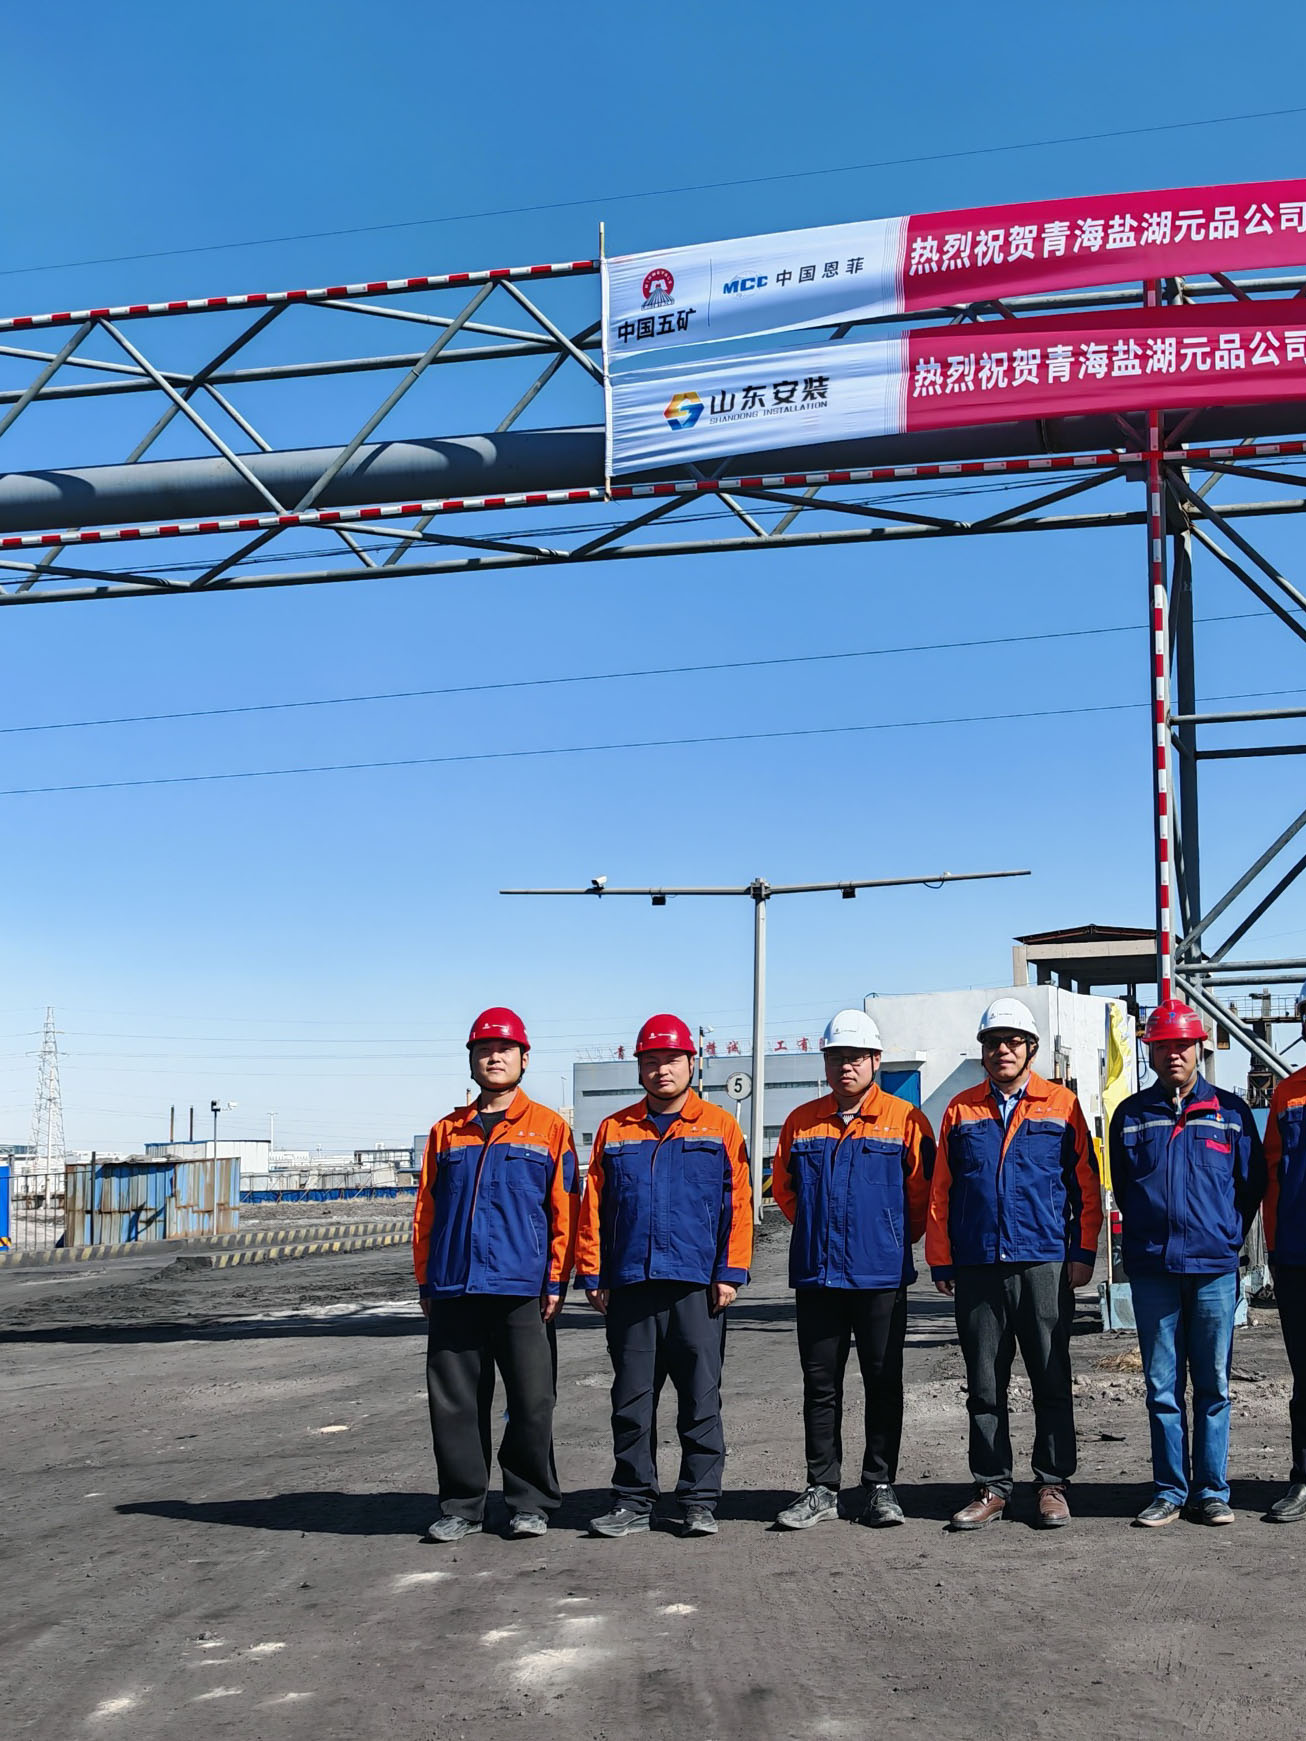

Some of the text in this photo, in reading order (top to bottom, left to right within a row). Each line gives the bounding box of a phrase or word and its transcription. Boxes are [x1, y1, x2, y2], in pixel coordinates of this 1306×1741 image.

[723, 257, 864, 294] MCC 中国恩菲
[618, 308, 696, 343] 中国五矿
[709, 400, 828, 425] SHANDONG INSTALLATION
[710, 375, 830, 415] 山东安装
[734, 1077, 743, 1093] 5
